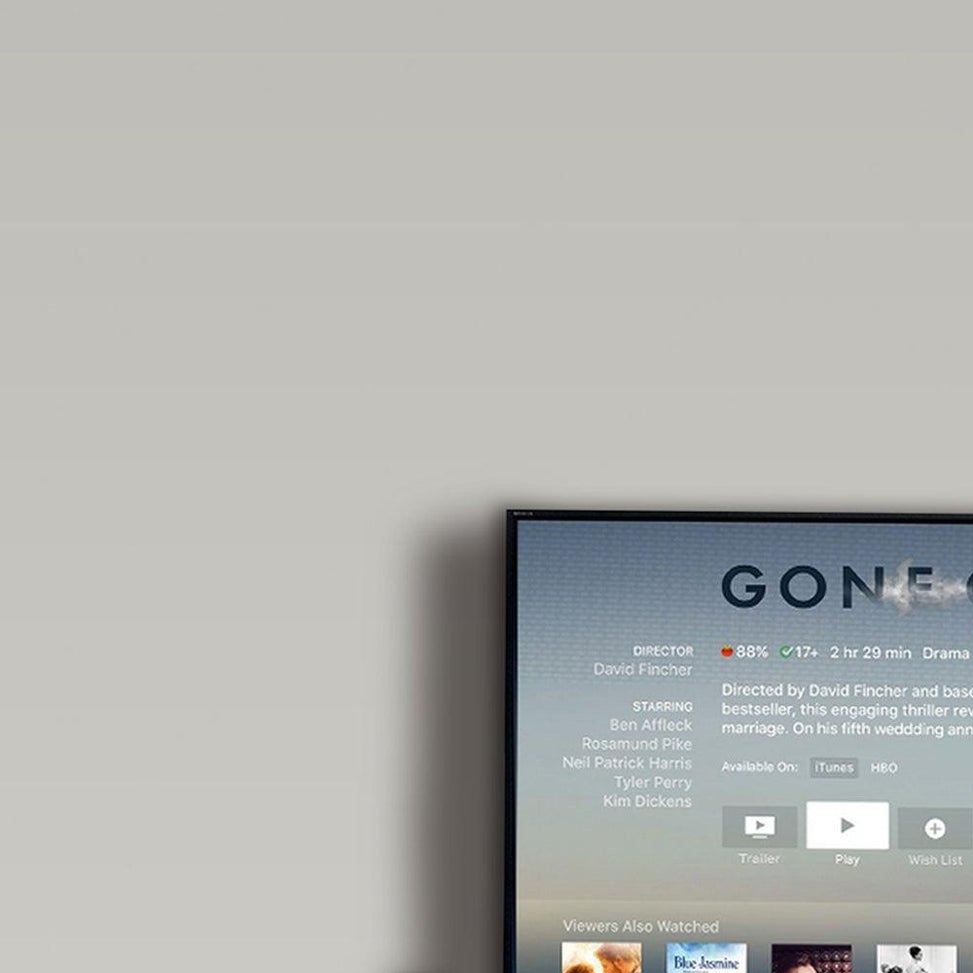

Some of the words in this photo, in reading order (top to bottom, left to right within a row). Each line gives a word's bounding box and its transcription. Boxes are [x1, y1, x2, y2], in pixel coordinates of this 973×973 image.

[721, 565, 934, 609] GONE
[633, 645, 694, 657] DIRECTOR
[735, 645, 768, 659] 88%
[795, 646, 818, 659] 17+
[829, 646, 839, 659] 2
[843, 646, 858, 659] hr
[862, 646, 881, 659] 29
[885, 646, 912, 660] min
[922, 647, 970, 660] Drama
[594, 662, 634, 676] David
[638, 662, 693, 676] Fincher
[721, 683, 783, 697] Directed
[787, 684, 804, 701] by
[809, 684, 850, 698] David
[854, 684, 907, 698] Fincher
[911, 684, 938, 698] and
[632, 701, 693, 712] STARRING
[721, 702, 796, 718] bestseller,
[800, 703, 827, 716] this
[831, 703, 898, 719] engaging
[902, 704, 950, 718] thriller
[609, 718, 638, 732] Ben
[641, 718, 693, 732] Affleck
[721, 722, 789, 738] marriage.
[793, 722, 814, 736] On
[817, 722, 838, 736] his
[841, 722, 871, 736] fifth
[874, 722, 944, 739] weddding
[582, 736, 658, 751] Rosamund
[662, 737, 693, 751] Pike
[562, 756, 591, 769] Neil
[594, 756, 644, 770] Patrick
[649, 756, 693, 770] Harris
[721, 760, 775, 773] Available
[777, 761, 799, 773] On:
[814, 761, 855, 773] iTunes
[870, 762, 898, 774] HBO
[613, 775, 650, 791] Tyler
[654, 776, 693, 792] Perry
[603, 794, 631, 808] Kim
[635, 794, 692, 808] Dickens
[738, 853, 780, 865] Trailer
[835, 854, 861, 868] Play
[909, 854, 938, 866] Wish
[941, 854, 963, 866] List
[562, 919, 619, 933] Viewers
[622, 919, 654, 933] Also
[656, 919, 720, 934] Watched
[673, 955, 697, 970] Blue
[697, 955, 740, 970] Jasmine
